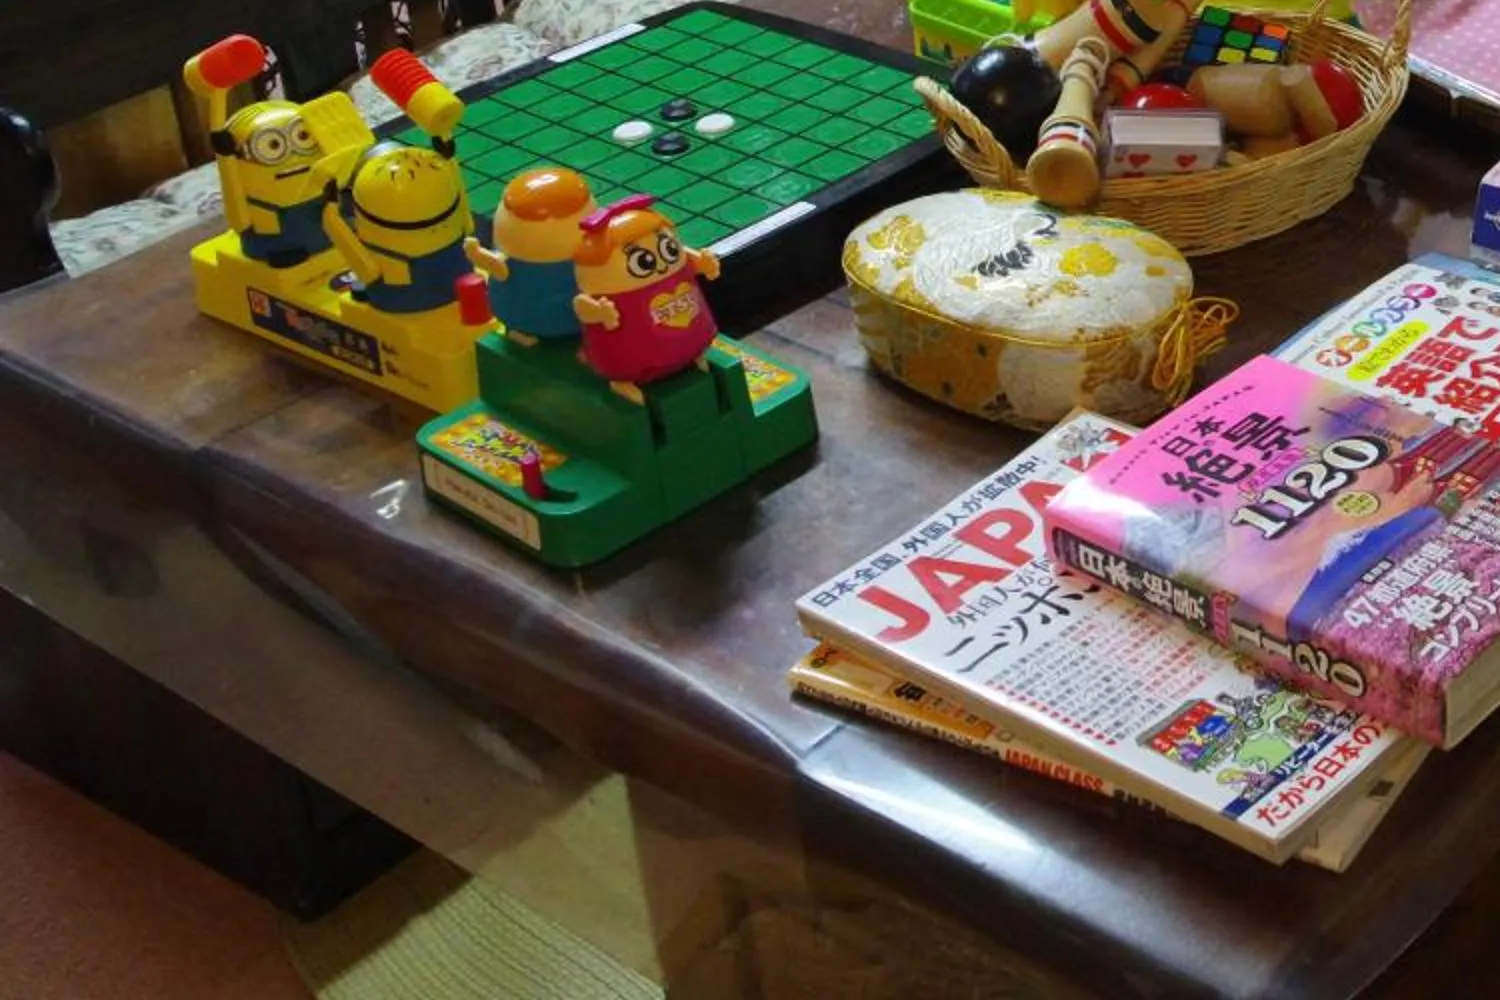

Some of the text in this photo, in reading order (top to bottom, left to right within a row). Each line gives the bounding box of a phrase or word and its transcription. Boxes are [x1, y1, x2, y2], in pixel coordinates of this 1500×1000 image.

[1376, 315, 1500, 397] 英語で
[1160, 411, 1311, 504] 絶景
[1229, 435, 1394, 541] 1120
[1230, 619, 1369, 699] 1120
